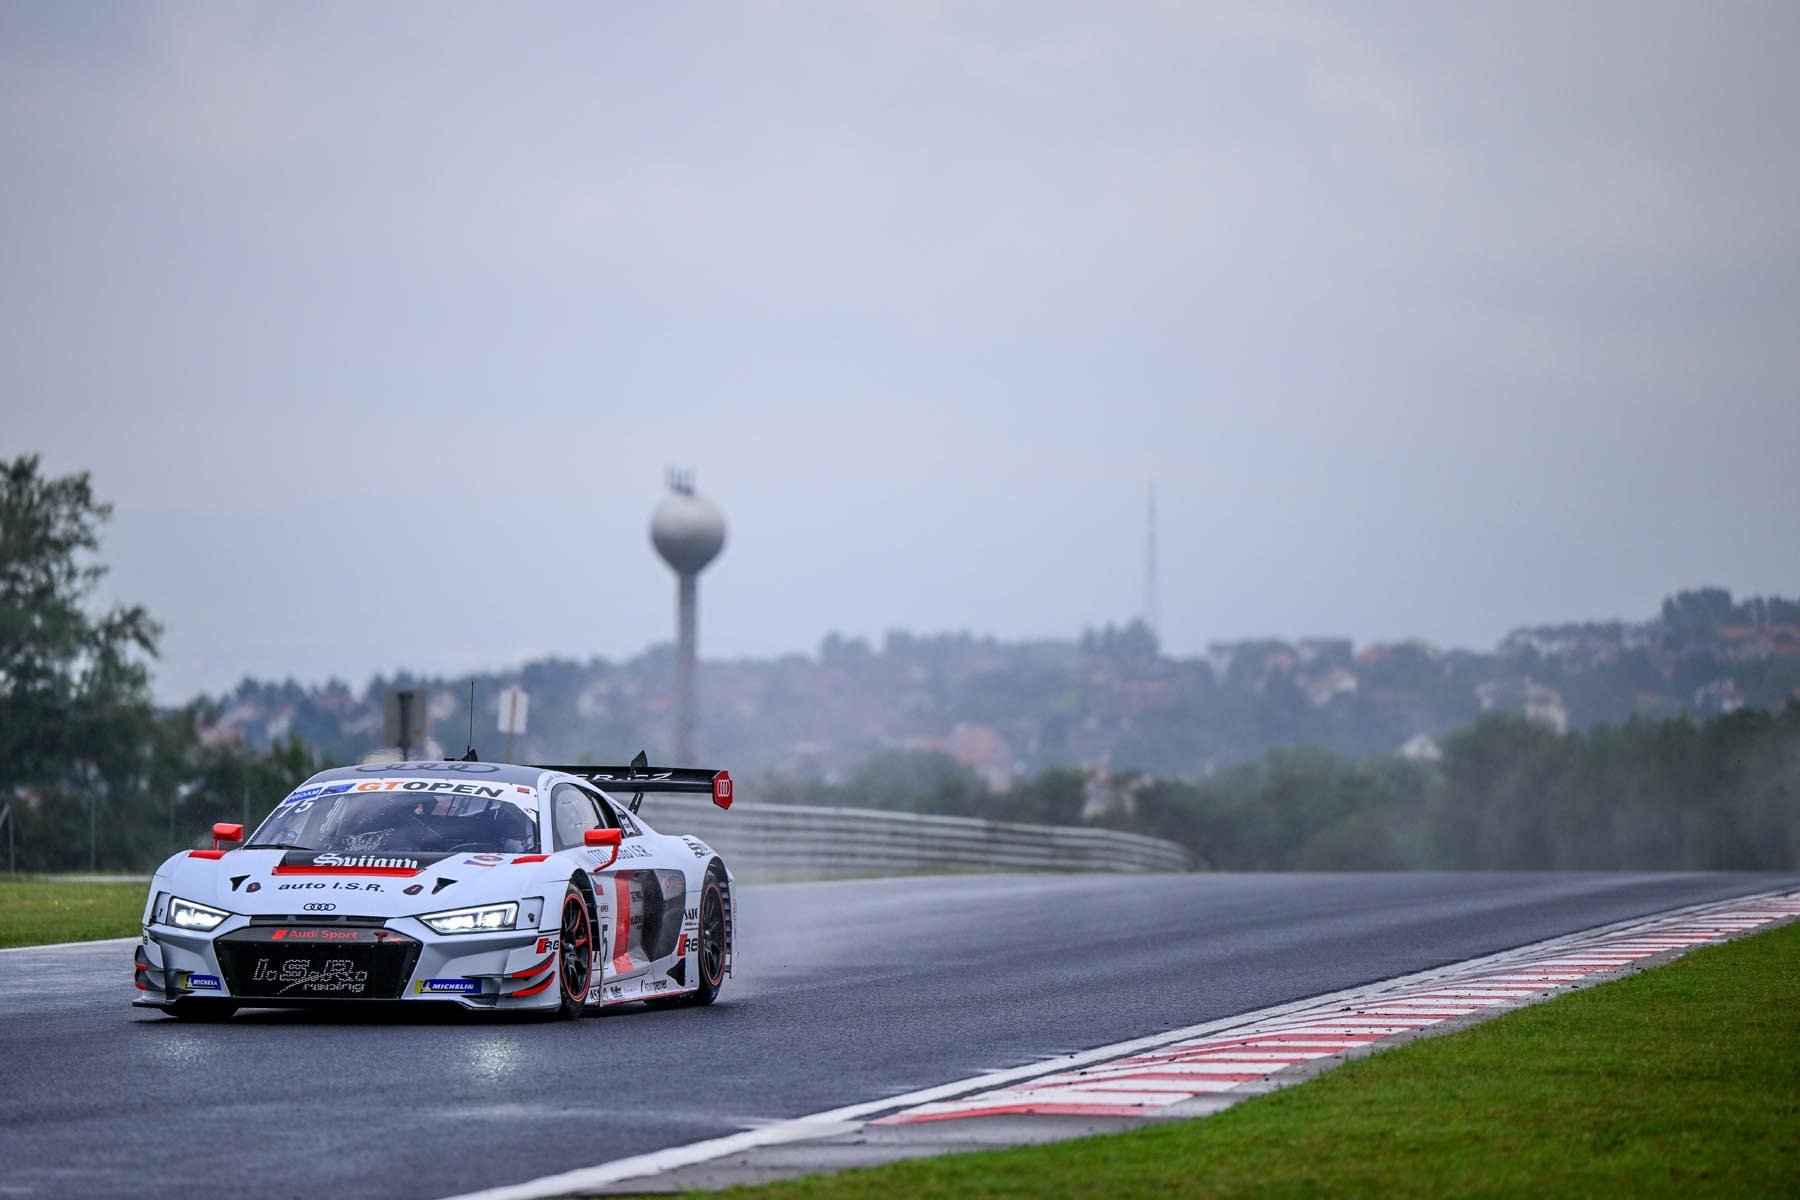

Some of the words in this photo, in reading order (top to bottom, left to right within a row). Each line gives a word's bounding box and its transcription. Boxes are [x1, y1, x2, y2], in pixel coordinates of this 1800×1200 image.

[278, 882, 326, 891] auto
[332, 882, 385, 893] I.S.R.
[288, 929, 318, 938] Audi
[321, 929, 359, 940] Sport
[302, 981, 366, 993] racing
